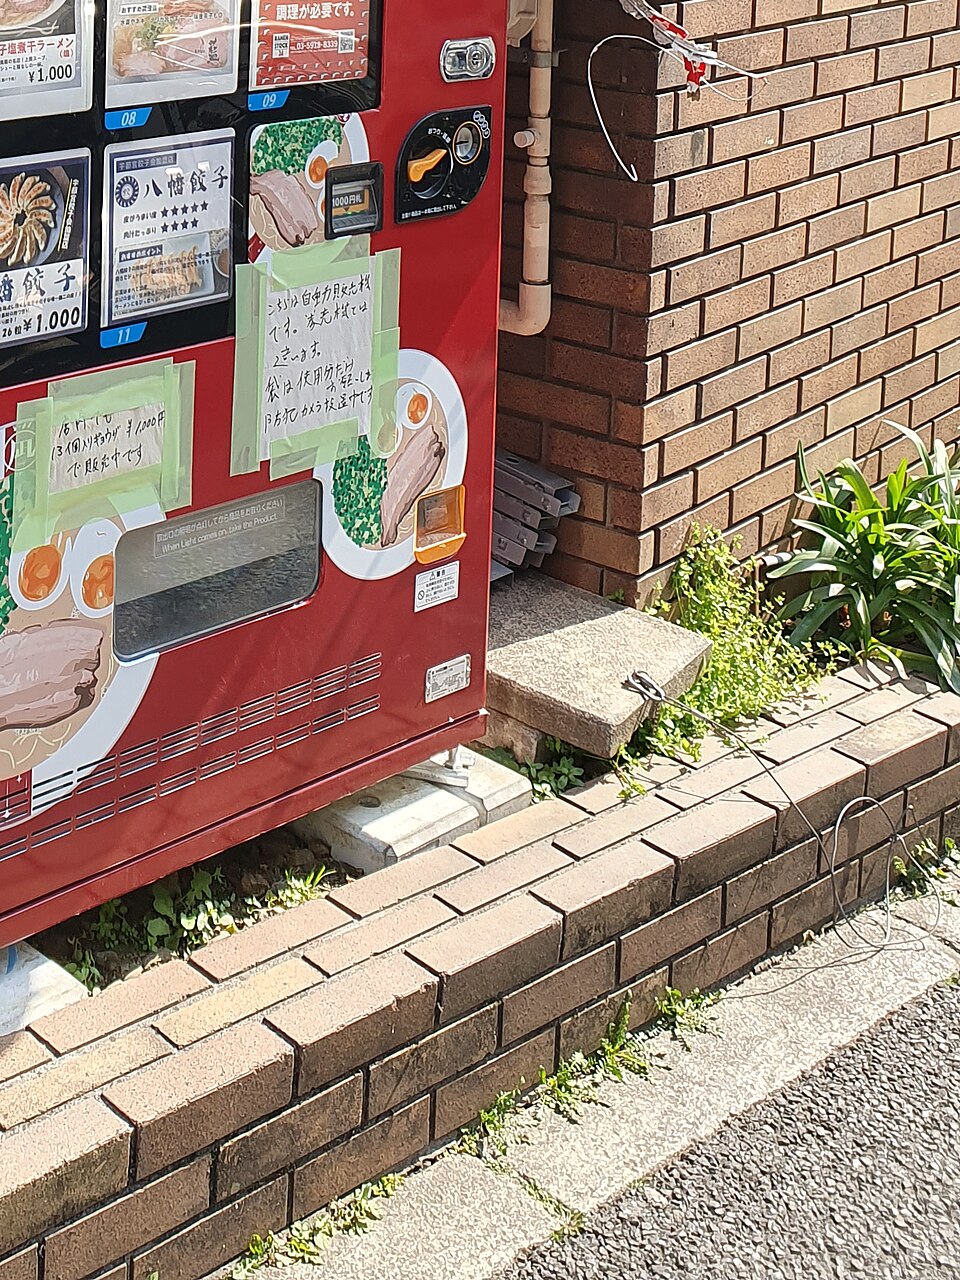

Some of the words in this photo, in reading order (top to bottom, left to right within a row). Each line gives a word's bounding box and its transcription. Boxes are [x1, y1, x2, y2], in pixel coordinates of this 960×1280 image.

[276, 1, 355, 21] 調理が必要です。
[28, 64, 73, 83] ¥1,000
[262, 93, 277, 108] 09
[121, 111, 137, 126] 08
[144, 165, 229, 199] 八幡餃子
[116, 329, 131, 344] 11
[66, 442, 143, 478] で販売中です
[161, 542, 181, 554] When
[180, 536, 198, 549] Light
[197, 532, 218, 543] comes
[242, 519, 254, 530] the
[253, 513, 279, 529] Product
